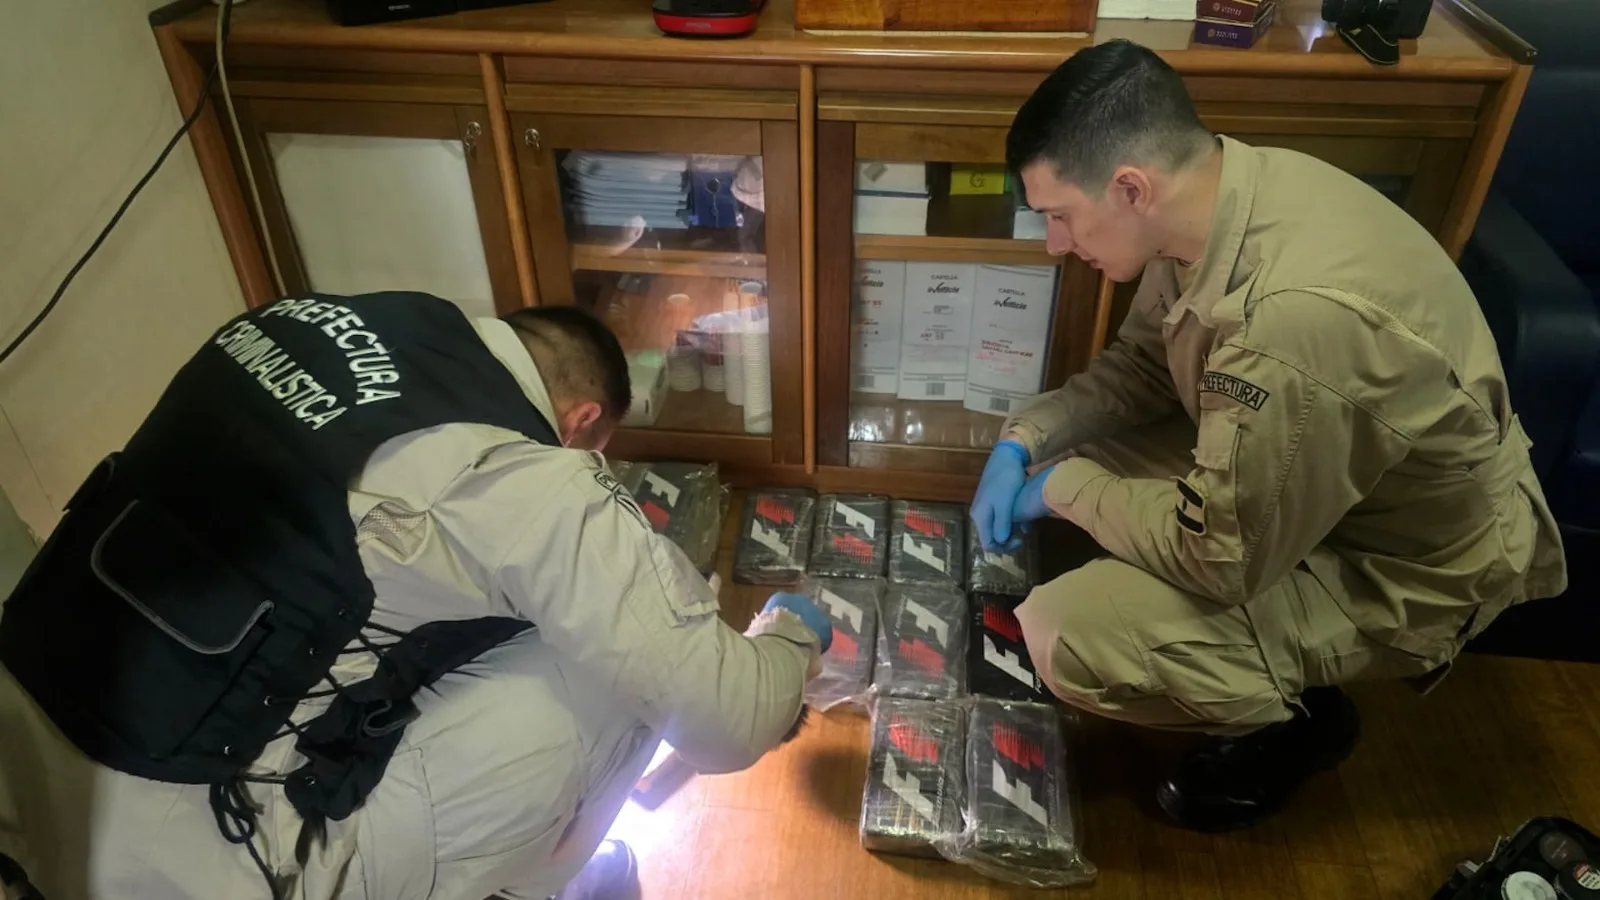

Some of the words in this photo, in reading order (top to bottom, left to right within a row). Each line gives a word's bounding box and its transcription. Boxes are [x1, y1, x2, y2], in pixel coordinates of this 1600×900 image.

[969, 172, 985, 188] G
[215, 319, 348, 430] CRIMINALISTICA
[259, 299, 401, 405] PREFECTURA
[1201, 374, 1260, 407] REFECTURA
